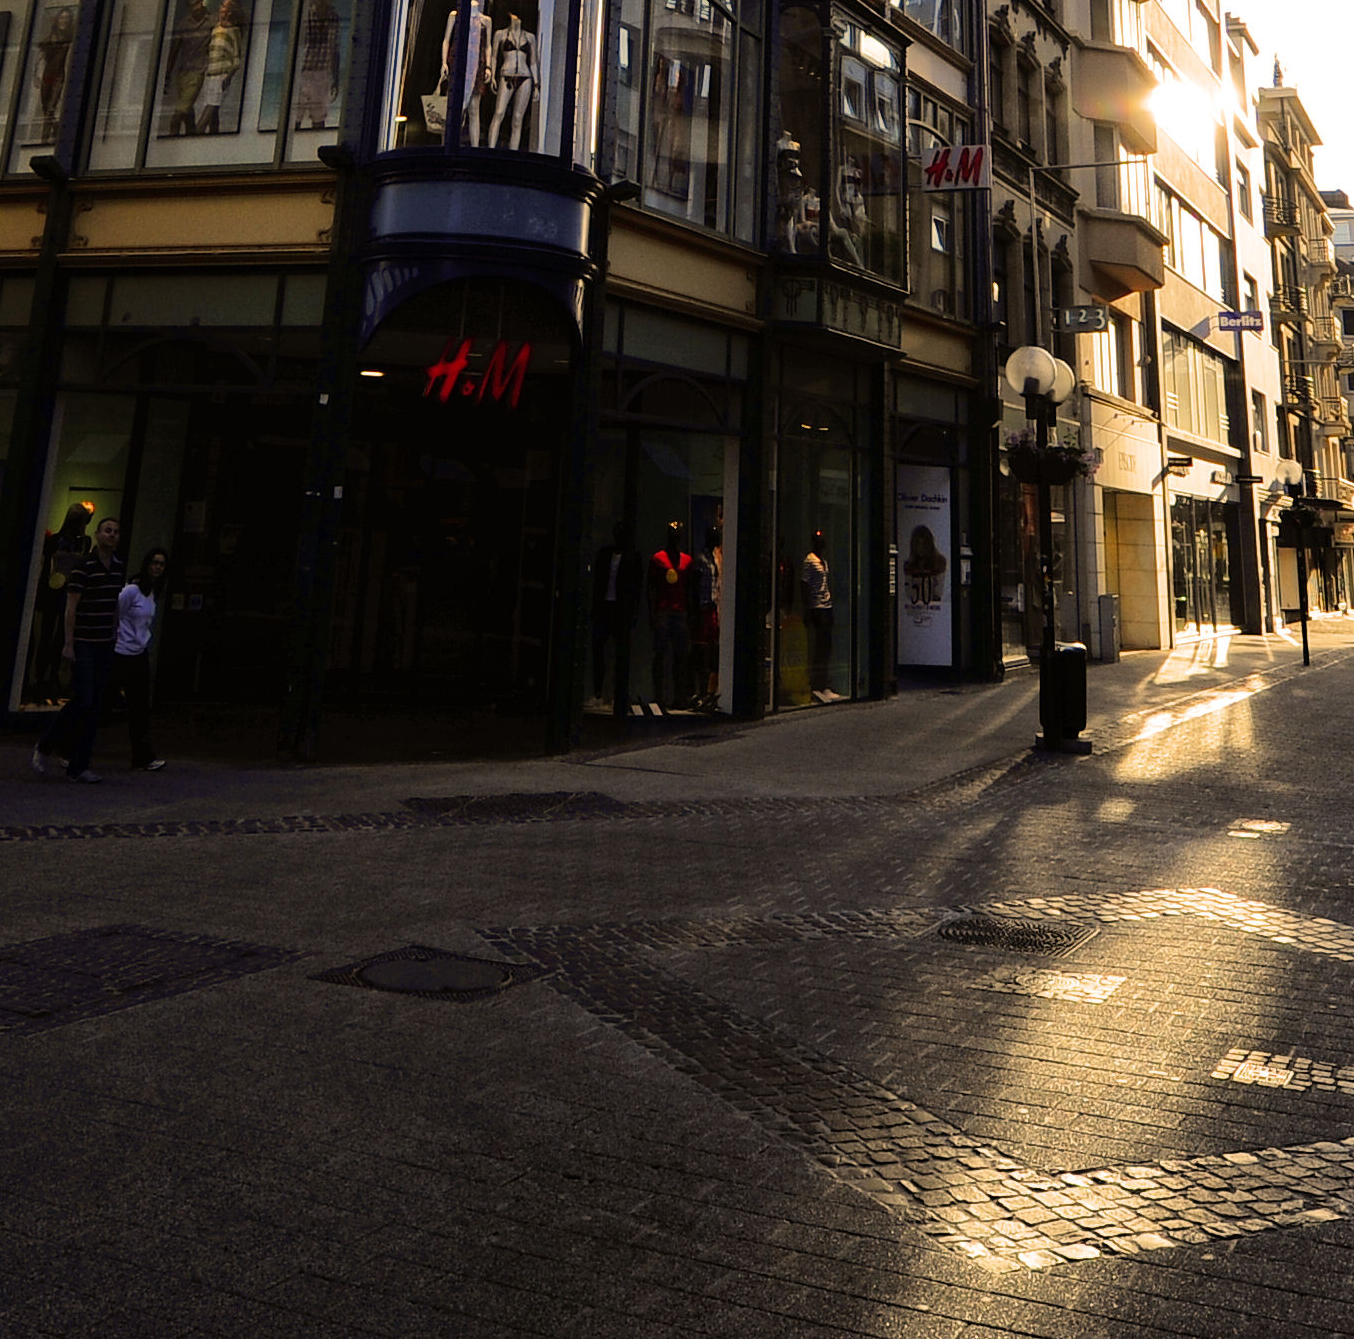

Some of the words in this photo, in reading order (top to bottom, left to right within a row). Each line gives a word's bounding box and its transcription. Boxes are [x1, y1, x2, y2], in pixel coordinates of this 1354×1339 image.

[924, 146, 984, 188] H&M
[1219, 314, 1262, 328] Berlitz
[424, 336, 533, 410] H&M
